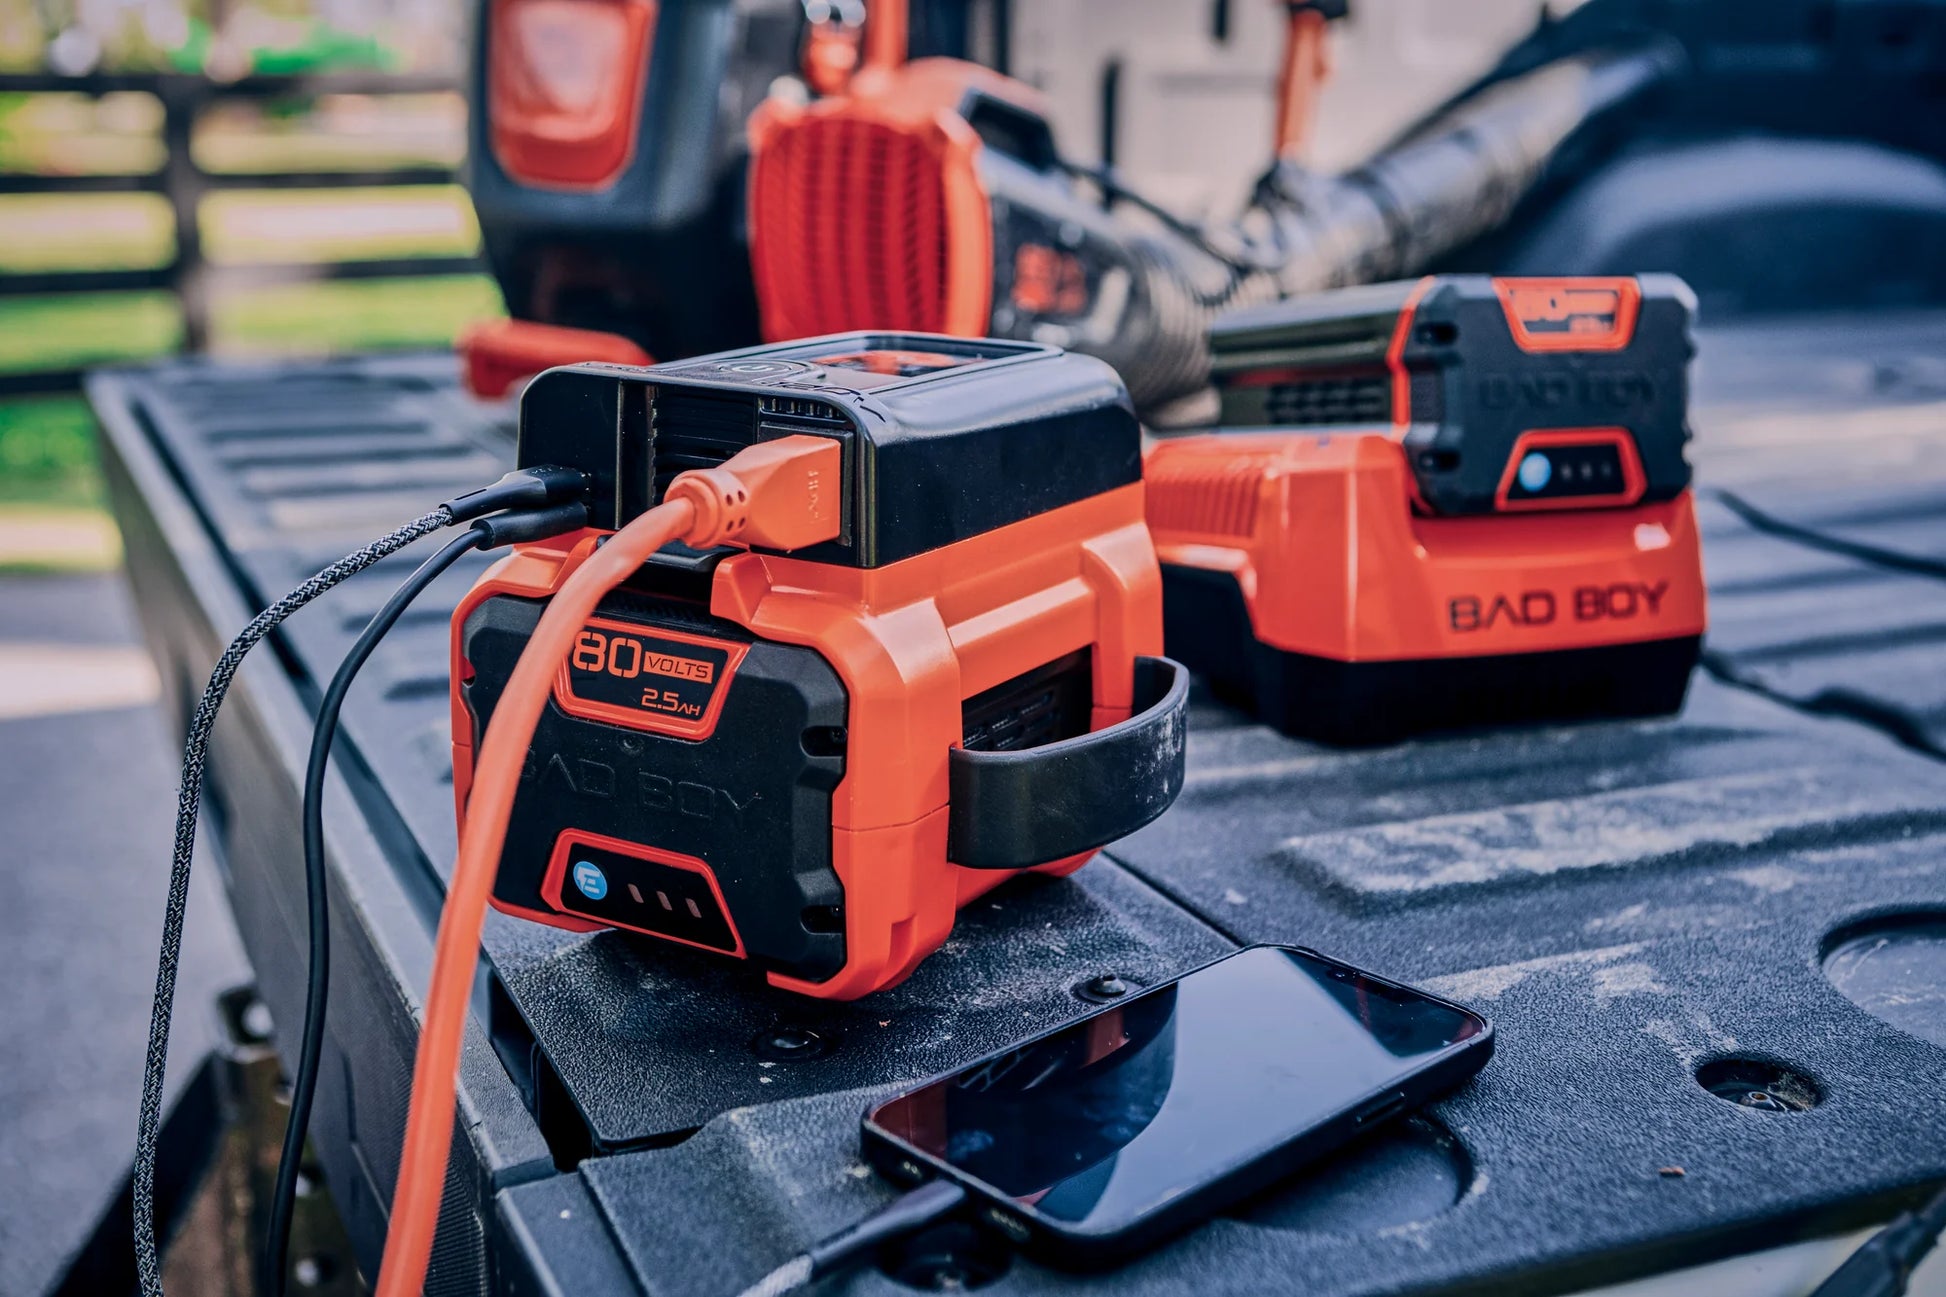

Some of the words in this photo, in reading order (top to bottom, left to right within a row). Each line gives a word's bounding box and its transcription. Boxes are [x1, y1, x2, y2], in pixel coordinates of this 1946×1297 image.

[1450, 589, 1557, 632] BAD
[1573, 578, 1669, 622] BOY
[572, 631, 642, 679] 80
[647, 654, 709, 680] VOLTS
[641, 687, 701, 717] 2.5AH
